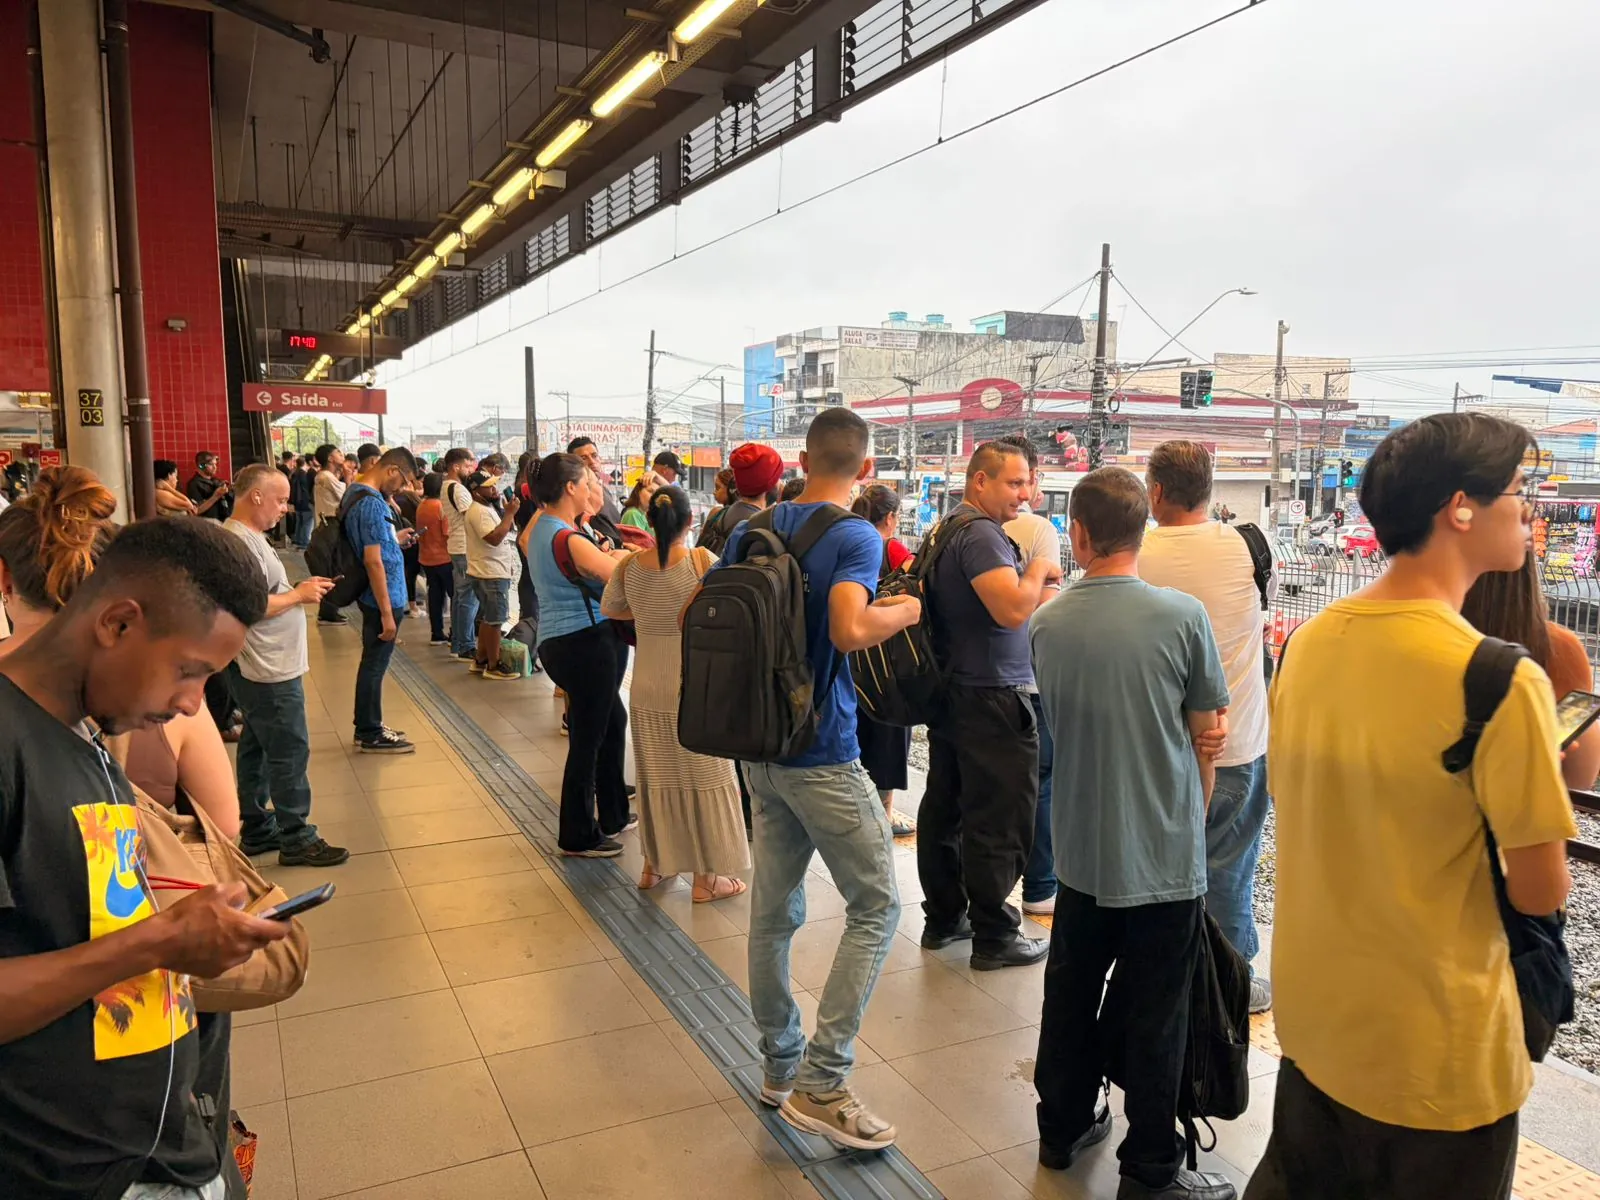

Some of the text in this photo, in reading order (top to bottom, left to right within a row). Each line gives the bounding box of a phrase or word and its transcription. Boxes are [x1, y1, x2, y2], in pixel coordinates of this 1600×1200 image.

[80, 392, 100, 406] 37
[281, 393, 329, 407] Saída
[82, 409, 103, 424] 03
[560, 423, 643, 433] ESTACIONAMENTO
